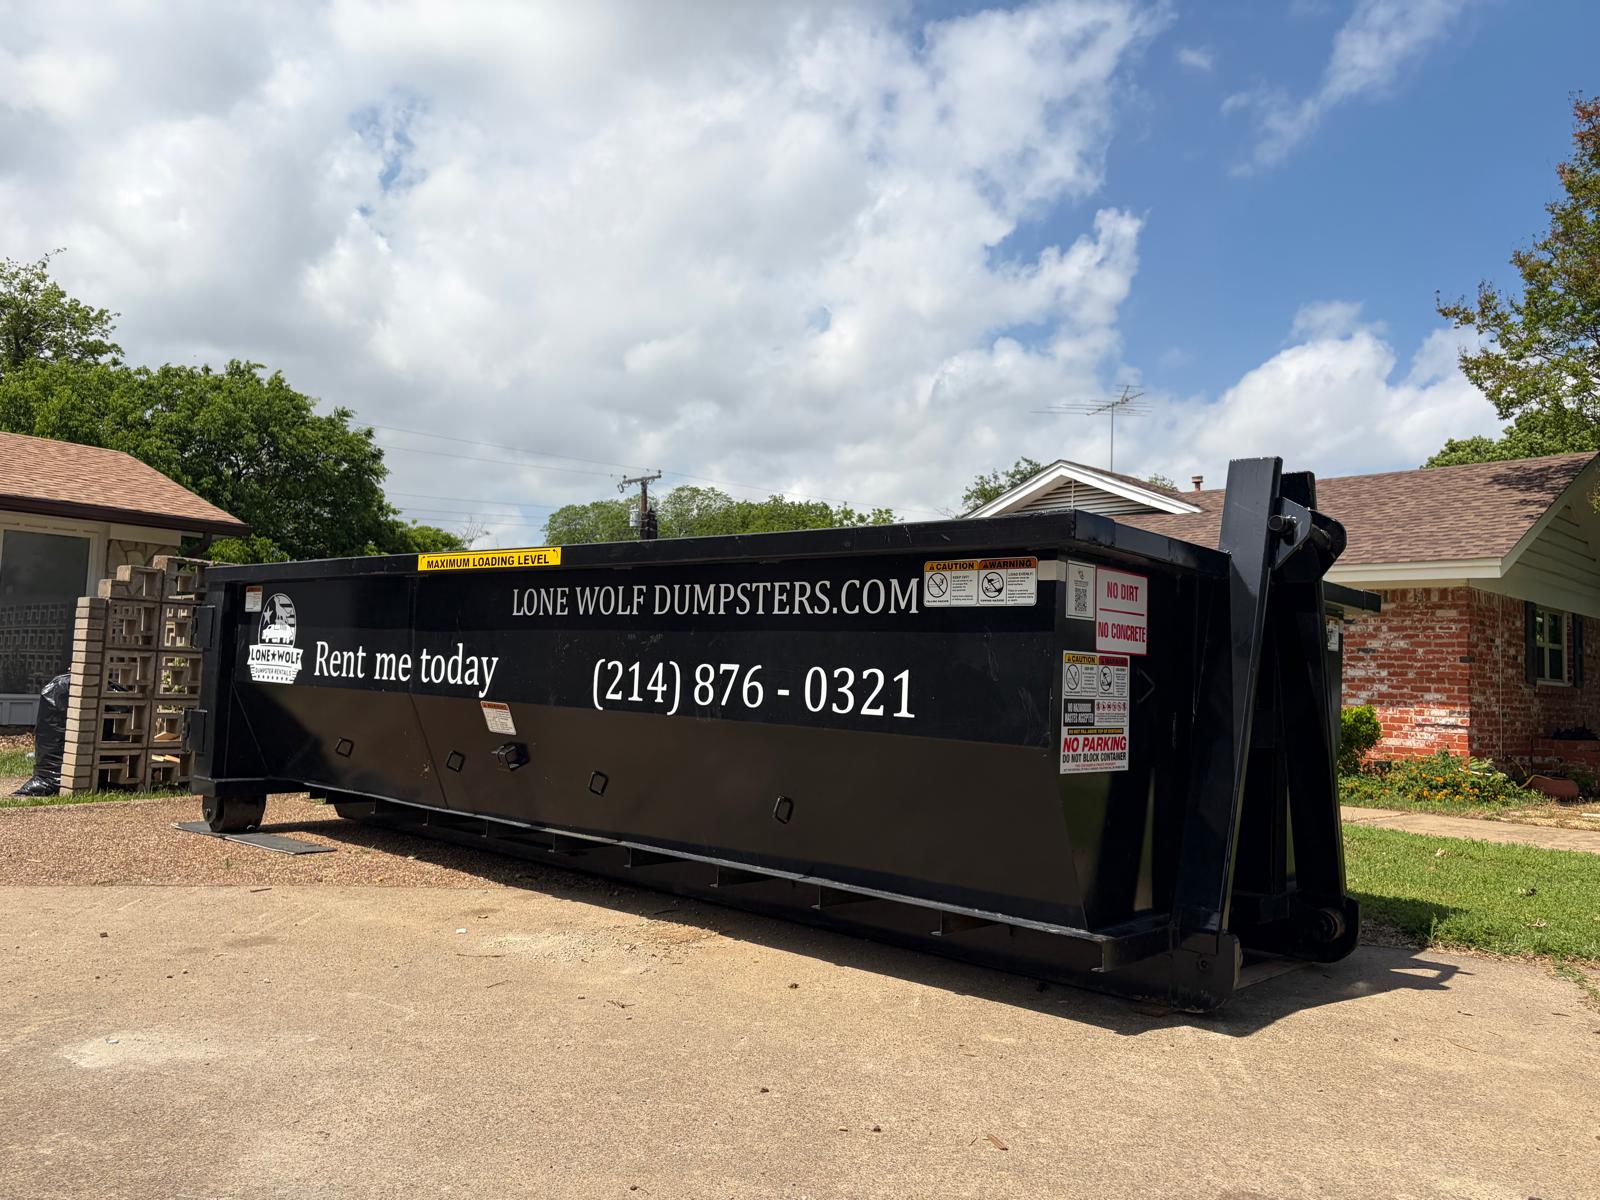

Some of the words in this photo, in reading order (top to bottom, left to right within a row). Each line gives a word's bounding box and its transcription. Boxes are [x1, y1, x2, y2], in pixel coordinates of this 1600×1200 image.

[427, 558, 470, 569] MAXIMUM
[472, 556, 515, 567] LOADING
[518, 554, 550, 565] LEVEL
[936, 562, 974, 571] CAUTION
[989, 560, 1032, 569] WARNING
[512, 587, 569, 616] LONE
[576, 585, 646, 616] WOLF
[653, 578, 920, 616] DUMPSTERS.COM
[1107, 581, 1118, 599] NO
[1121, 583, 1139, 602] DIRT
[1098, 621, 1109, 638] NO
[1111, 623, 1146, 643] CONCRETE
[251, 648, 270, 662] LONE
[277, 650, 300, 665] WOLF
[1072, 655, 1096, 664] CAUTION
[255, 667, 274, 675] DUMPSTER
[274, 668, 292, 677] RENTALS
[314, 641, 366, 678] Rent
[374, 652, 412, 682] me
[420, 643, 499, 698] today
[593, 658, 681, 716] (214)
[693, 663, 764, 709] 876
[804, 666, 916, 718] 0321
[1063, 736, 1080, 752] NO
[1082, 736, 1127, 752] PARKING
[1062, 754, 1070, 763] DO
[1071, 753, 1082, 763] NOT
[1083, 752, 1100, 762] BLOCK
[1101, 752, 1127, 762] CONTAINER
